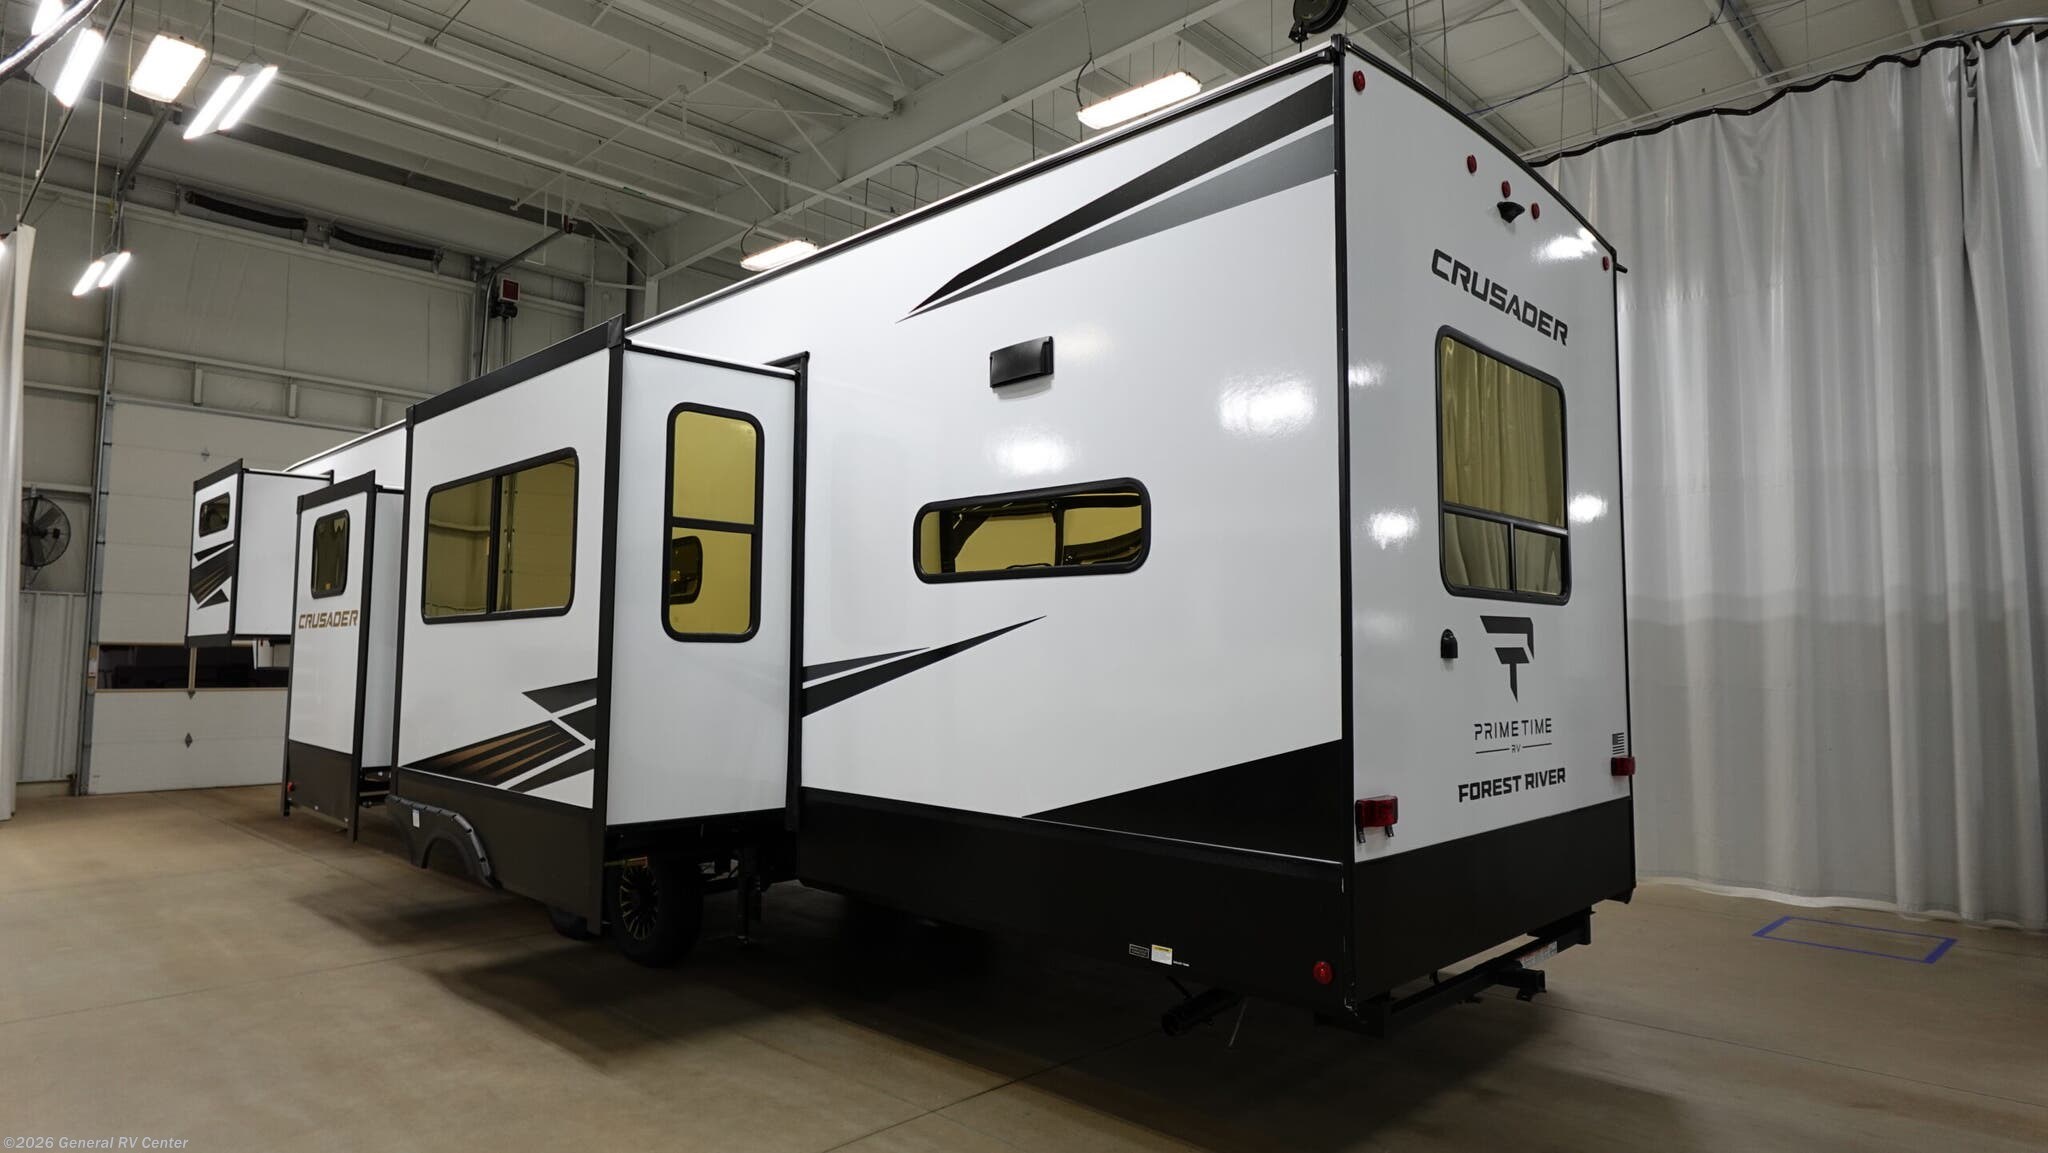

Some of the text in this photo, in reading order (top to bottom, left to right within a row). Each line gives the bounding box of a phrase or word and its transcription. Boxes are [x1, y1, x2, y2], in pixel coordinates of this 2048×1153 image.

[1431, 248, 1569, 346] CRUSADER
[298, 609, 359, 629] CRUSADER
[1511, 744, 1521, 753] RV
[1458, 767, 1566, 803] FOREST RIVER
